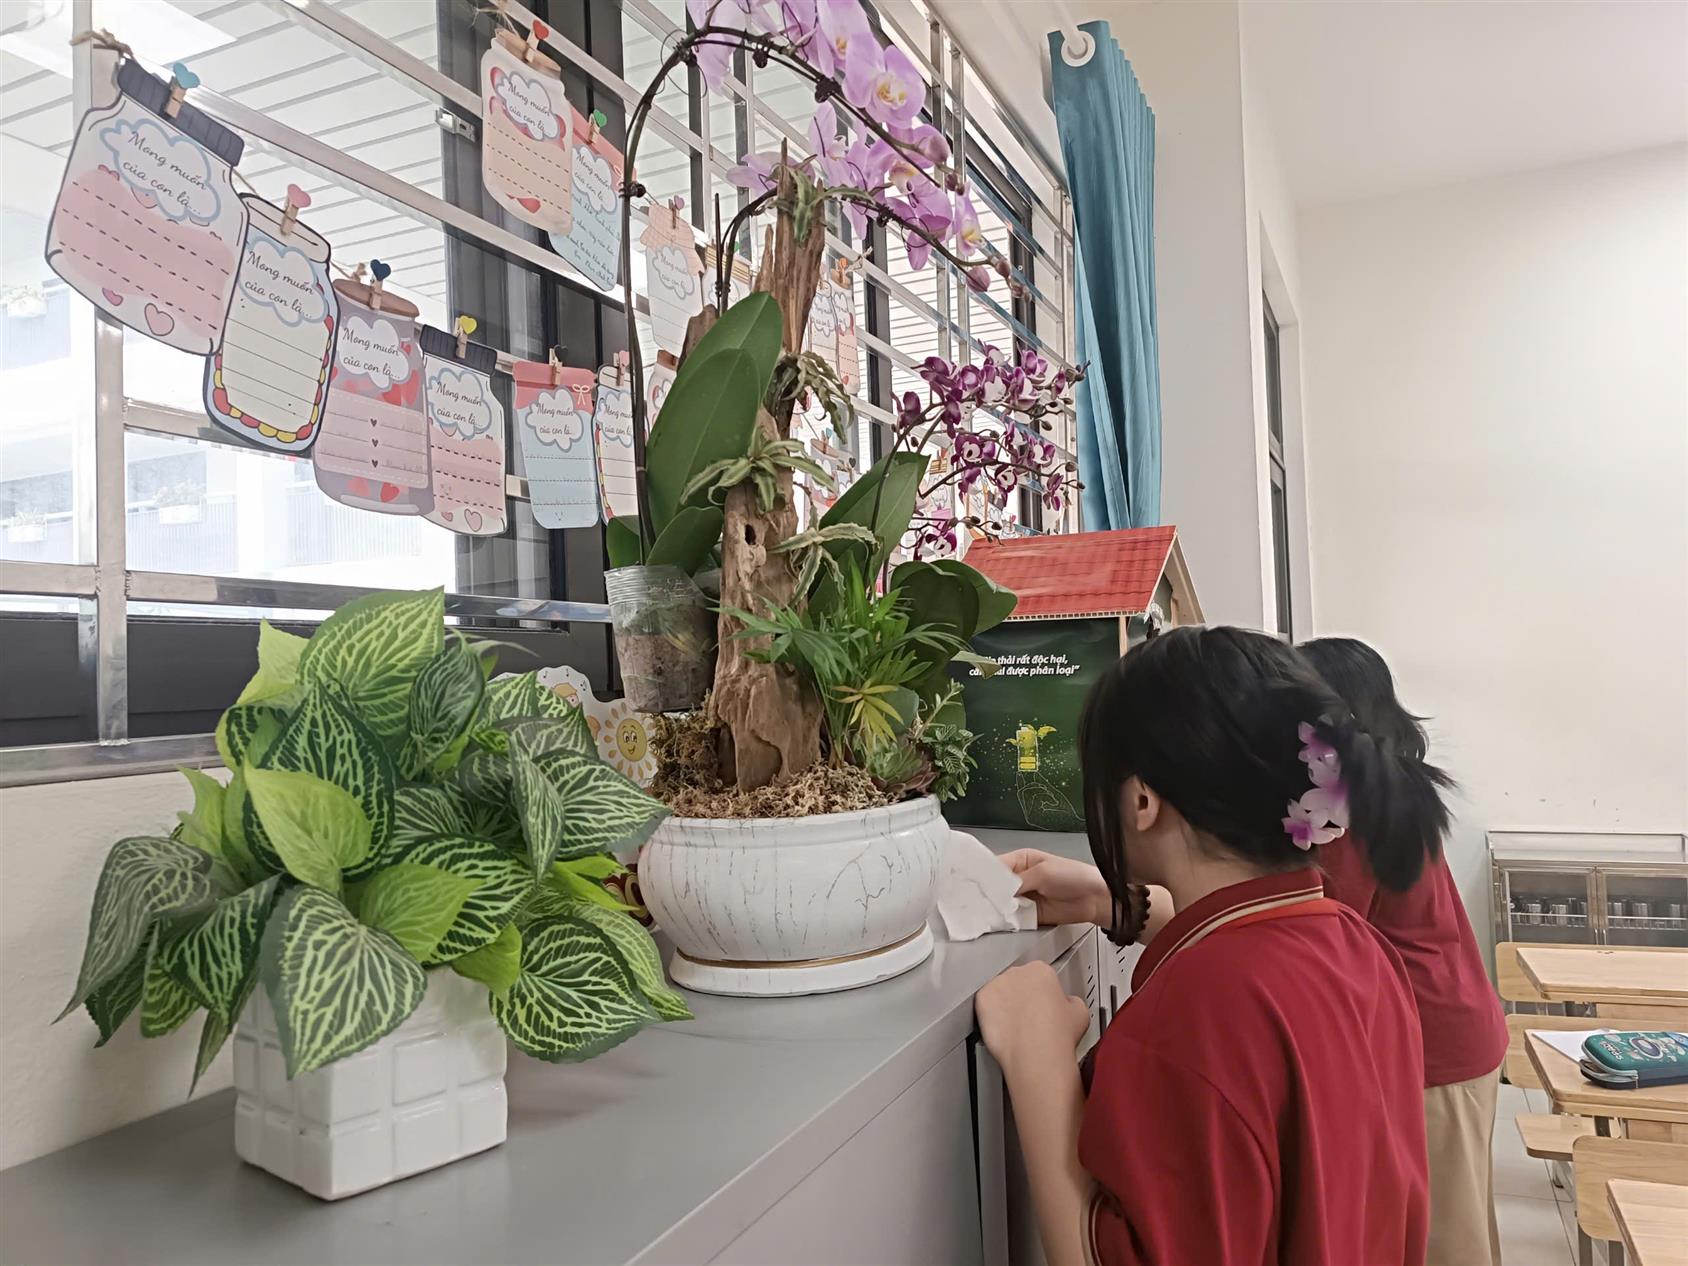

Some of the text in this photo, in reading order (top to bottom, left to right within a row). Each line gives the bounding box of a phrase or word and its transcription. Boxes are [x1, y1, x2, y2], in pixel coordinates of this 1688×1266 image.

[128, 131, 206, 190] Mong muốn
[123, 162, 147, 181] của
[150, 179, 174, 197] con
[246, 251, 314, 295] Mong muốn
[244, 281, 266, 296] của
[269, 293, 288, 306] con
[342, 327, 399, 356] Mong muốn
[343, 356, 361, 368] của
[363, 362, 379, 373] con
[436, 381, 482, 406] Mong muốn
[453, 413, 466, 422] con
[997, 655, 1015, 665] thải
[1016, 654, 1031, 664] rất
[1031, 654, 1049, 666] độc
[1006, 666, 1029, 677] được
[1029, 666, 1054, 677] phân
